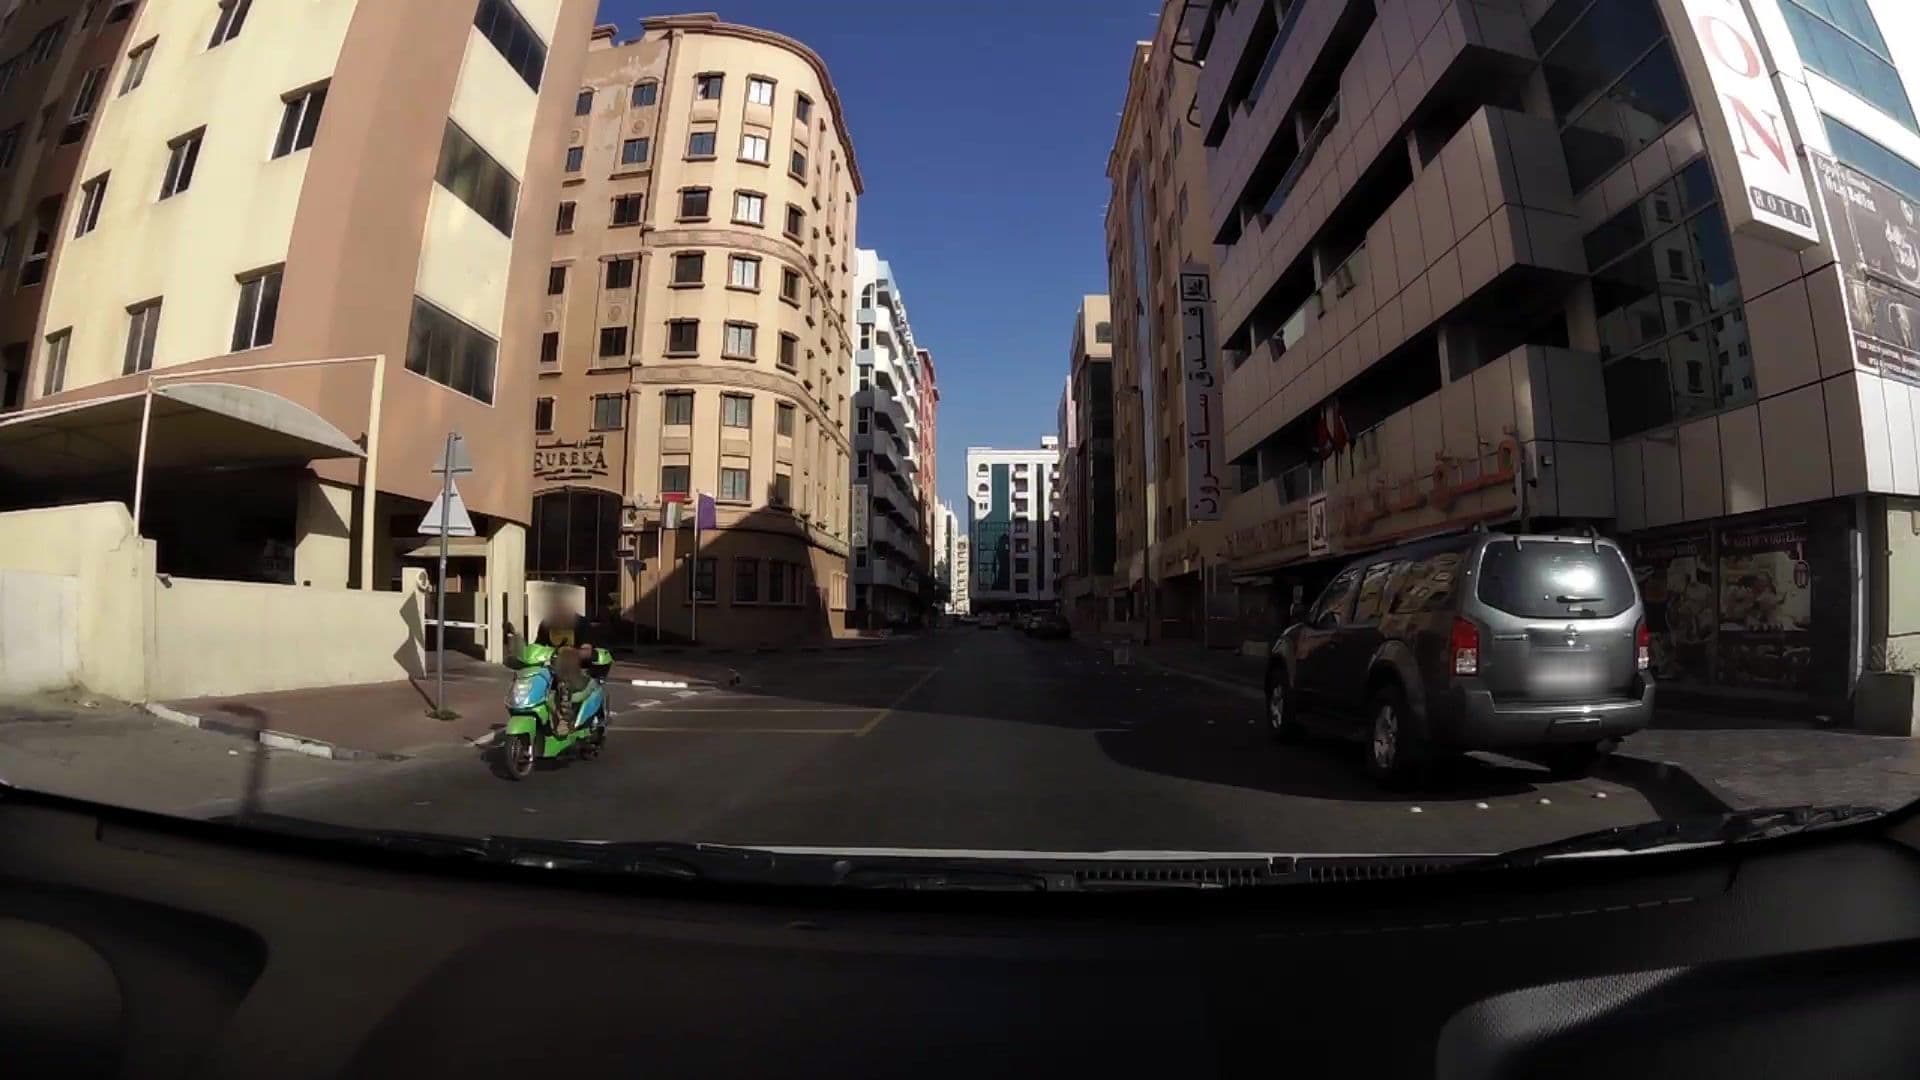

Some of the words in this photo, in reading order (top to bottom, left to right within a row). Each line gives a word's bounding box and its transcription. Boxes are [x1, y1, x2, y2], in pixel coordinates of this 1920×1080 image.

[1702, 0, 1791, 175] ON
[1752, 188, 1812, 228] HOTEL
[1184, 306, 1214, 388] فندق
[533, 450, 609, 472] EUREKA
